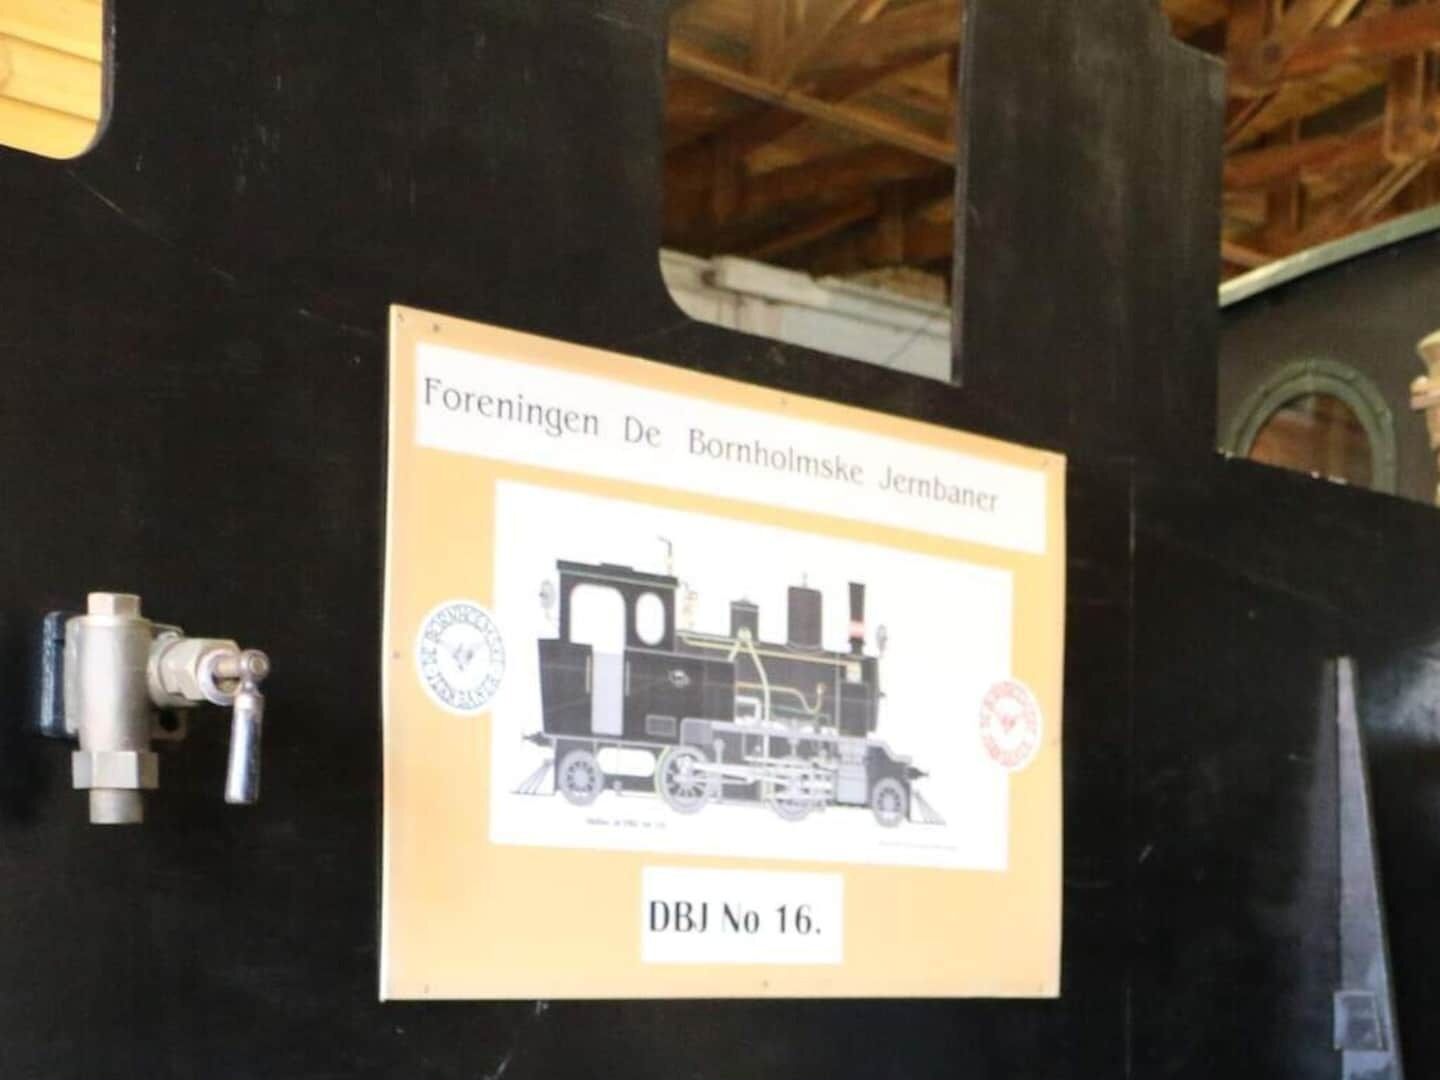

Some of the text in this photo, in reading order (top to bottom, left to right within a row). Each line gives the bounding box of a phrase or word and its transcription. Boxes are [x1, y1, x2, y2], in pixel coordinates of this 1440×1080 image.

[423, 376, 998, 513] Foreningen De Bornholmske Jernbaner
[649, 899, 822, 935] DBJ No 16.
